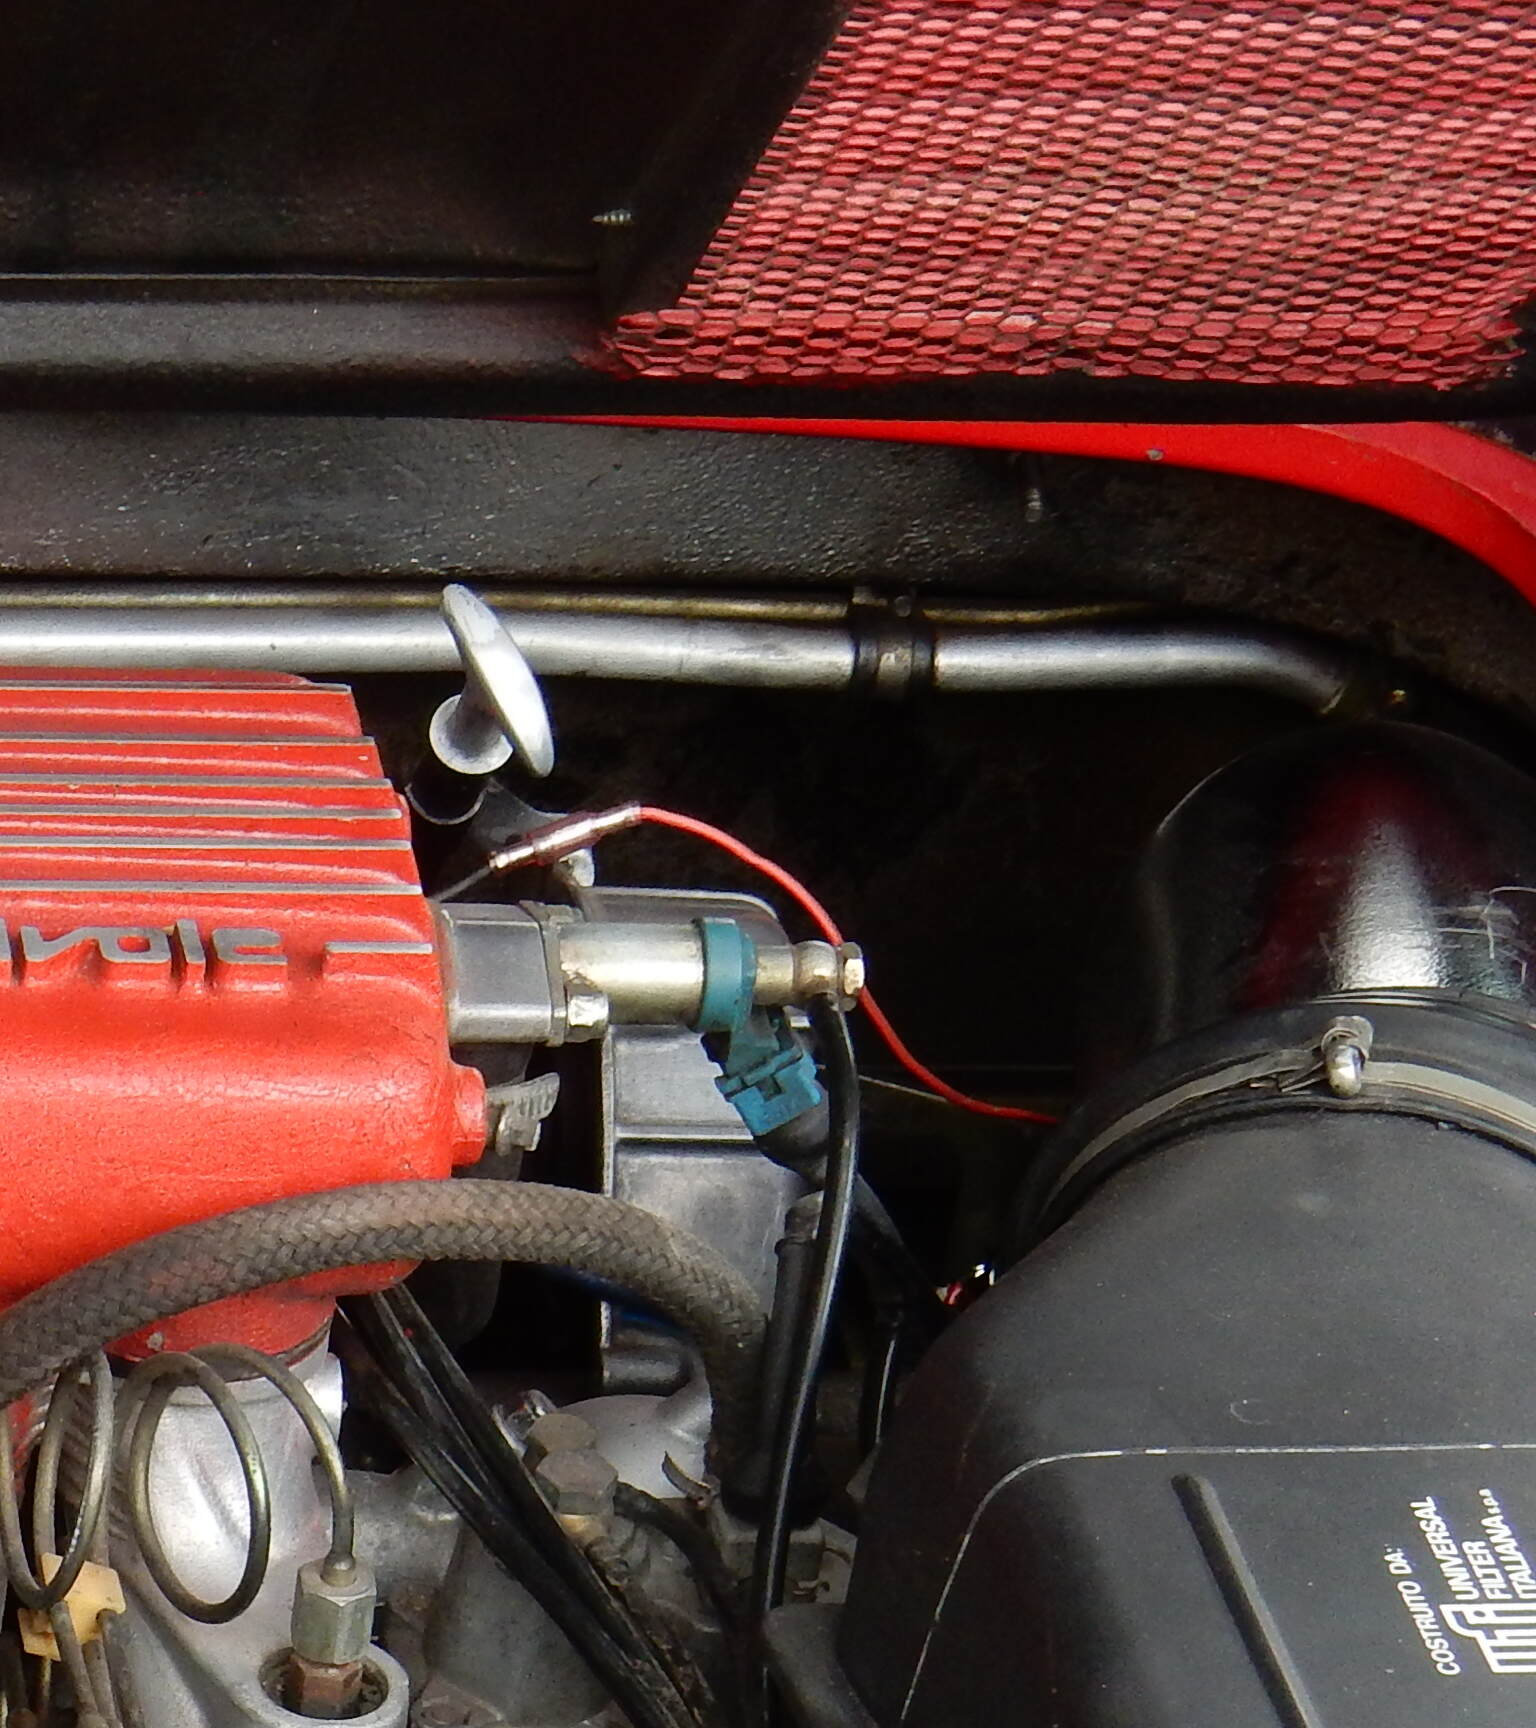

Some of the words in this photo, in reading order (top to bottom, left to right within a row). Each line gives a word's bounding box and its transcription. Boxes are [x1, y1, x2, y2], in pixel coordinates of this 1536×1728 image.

[1410, 1496, 1480, 1600] UNIVERSAL
[1461, 1540, 1513, 1600] FILTER
[1480, 1514, 1536, 1600] ITALIANA
[1397, 1580, 1461, 1675] COSTRUITO
